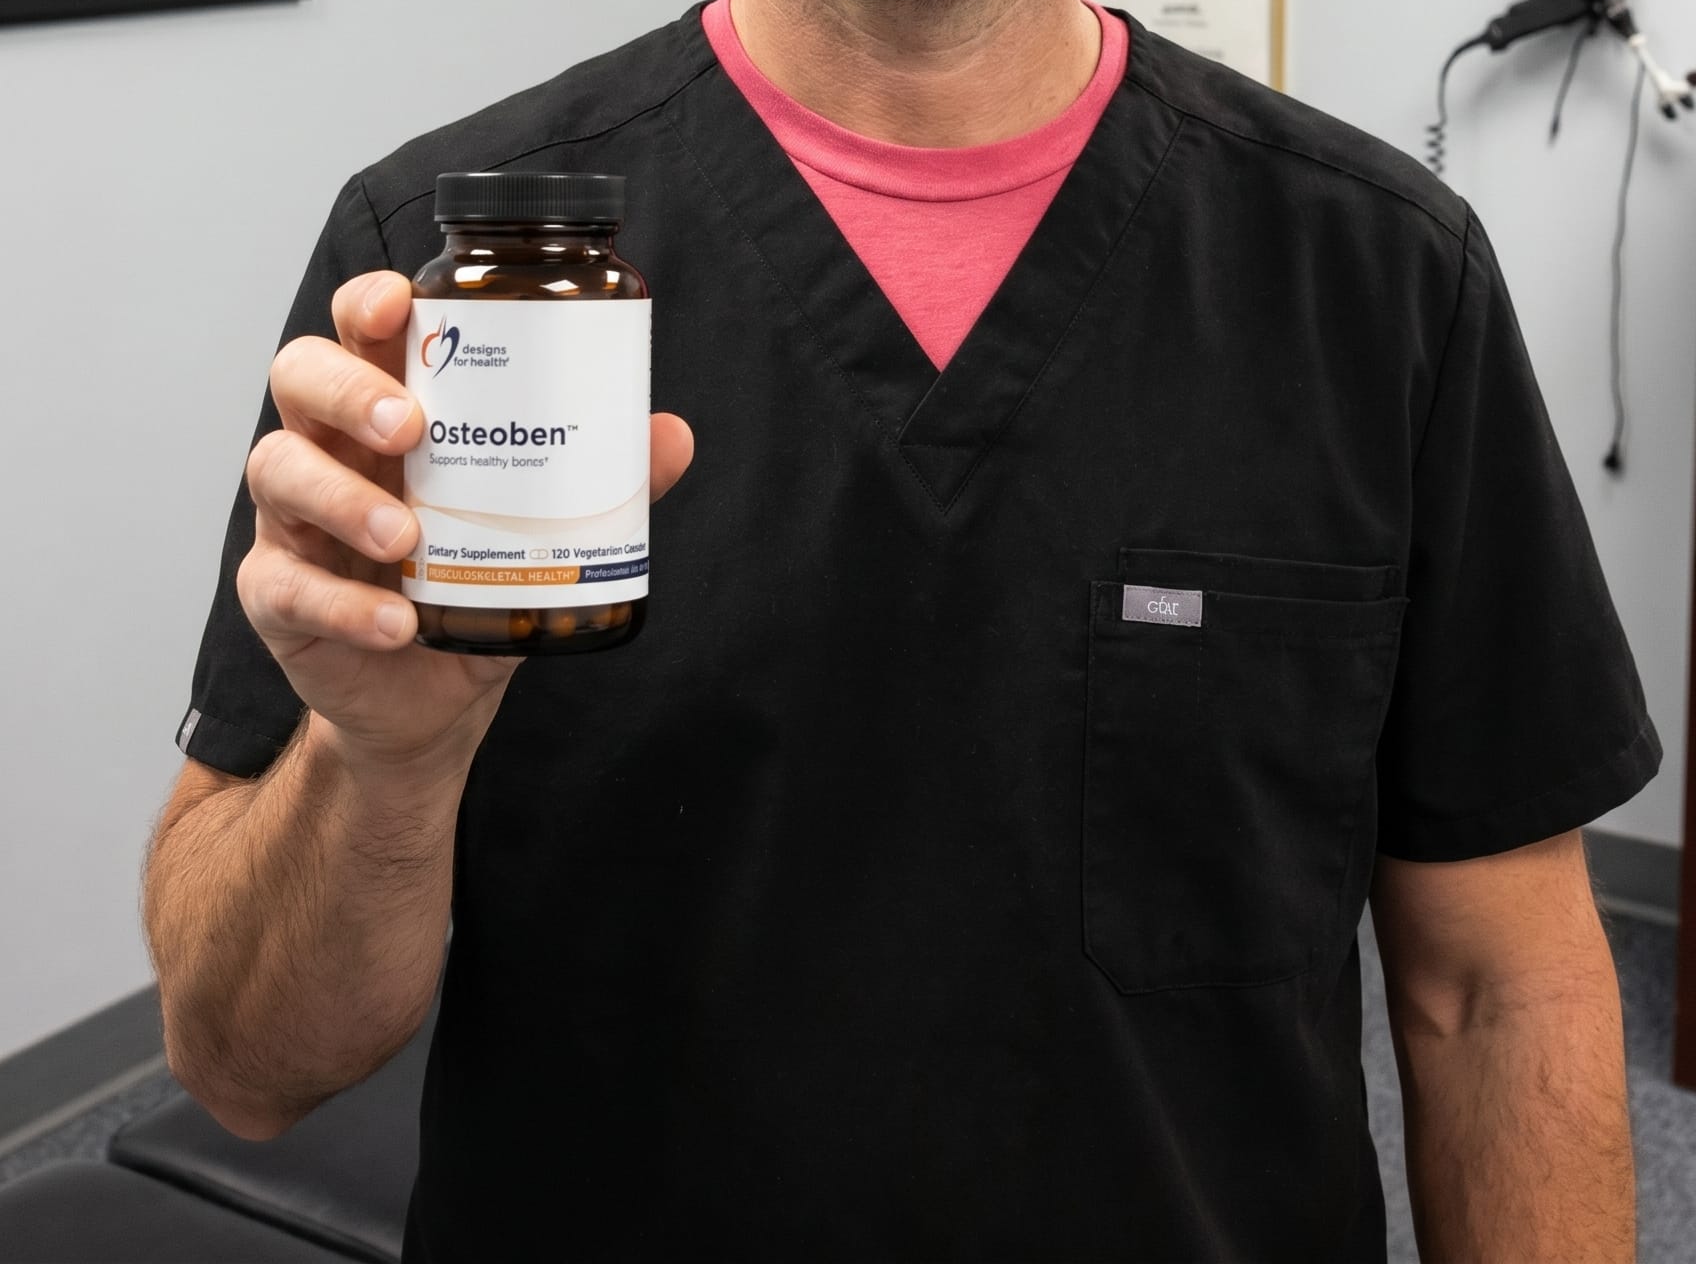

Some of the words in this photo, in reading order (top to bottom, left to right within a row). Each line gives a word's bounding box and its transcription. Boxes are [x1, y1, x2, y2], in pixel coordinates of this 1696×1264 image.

[462, 344, 506, 356] designs
[453, 356, 468, 366] for
[470, 455, 508, 469] healthy
[461, 547, 526, 561] Supplement
[552, 548, 570, 559] 120
